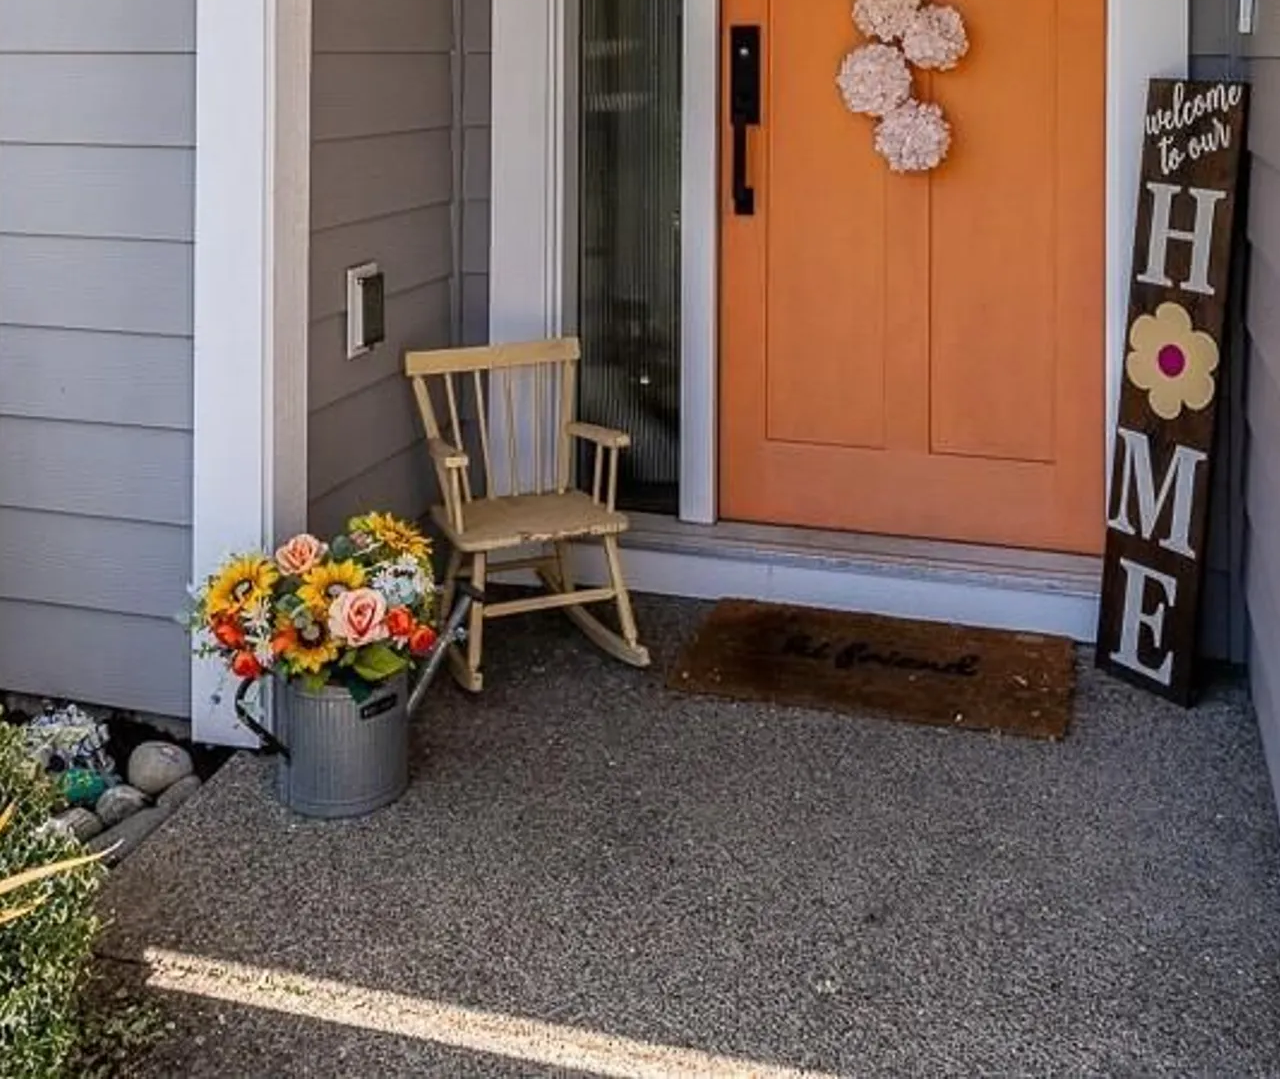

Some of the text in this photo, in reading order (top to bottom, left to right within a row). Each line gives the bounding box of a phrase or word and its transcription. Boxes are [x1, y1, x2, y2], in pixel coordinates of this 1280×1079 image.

[1146, 82, 1242, 134] welcome
[1157, 117, 1231, 174] to our
[1107, 182, 1227, 685] HME
